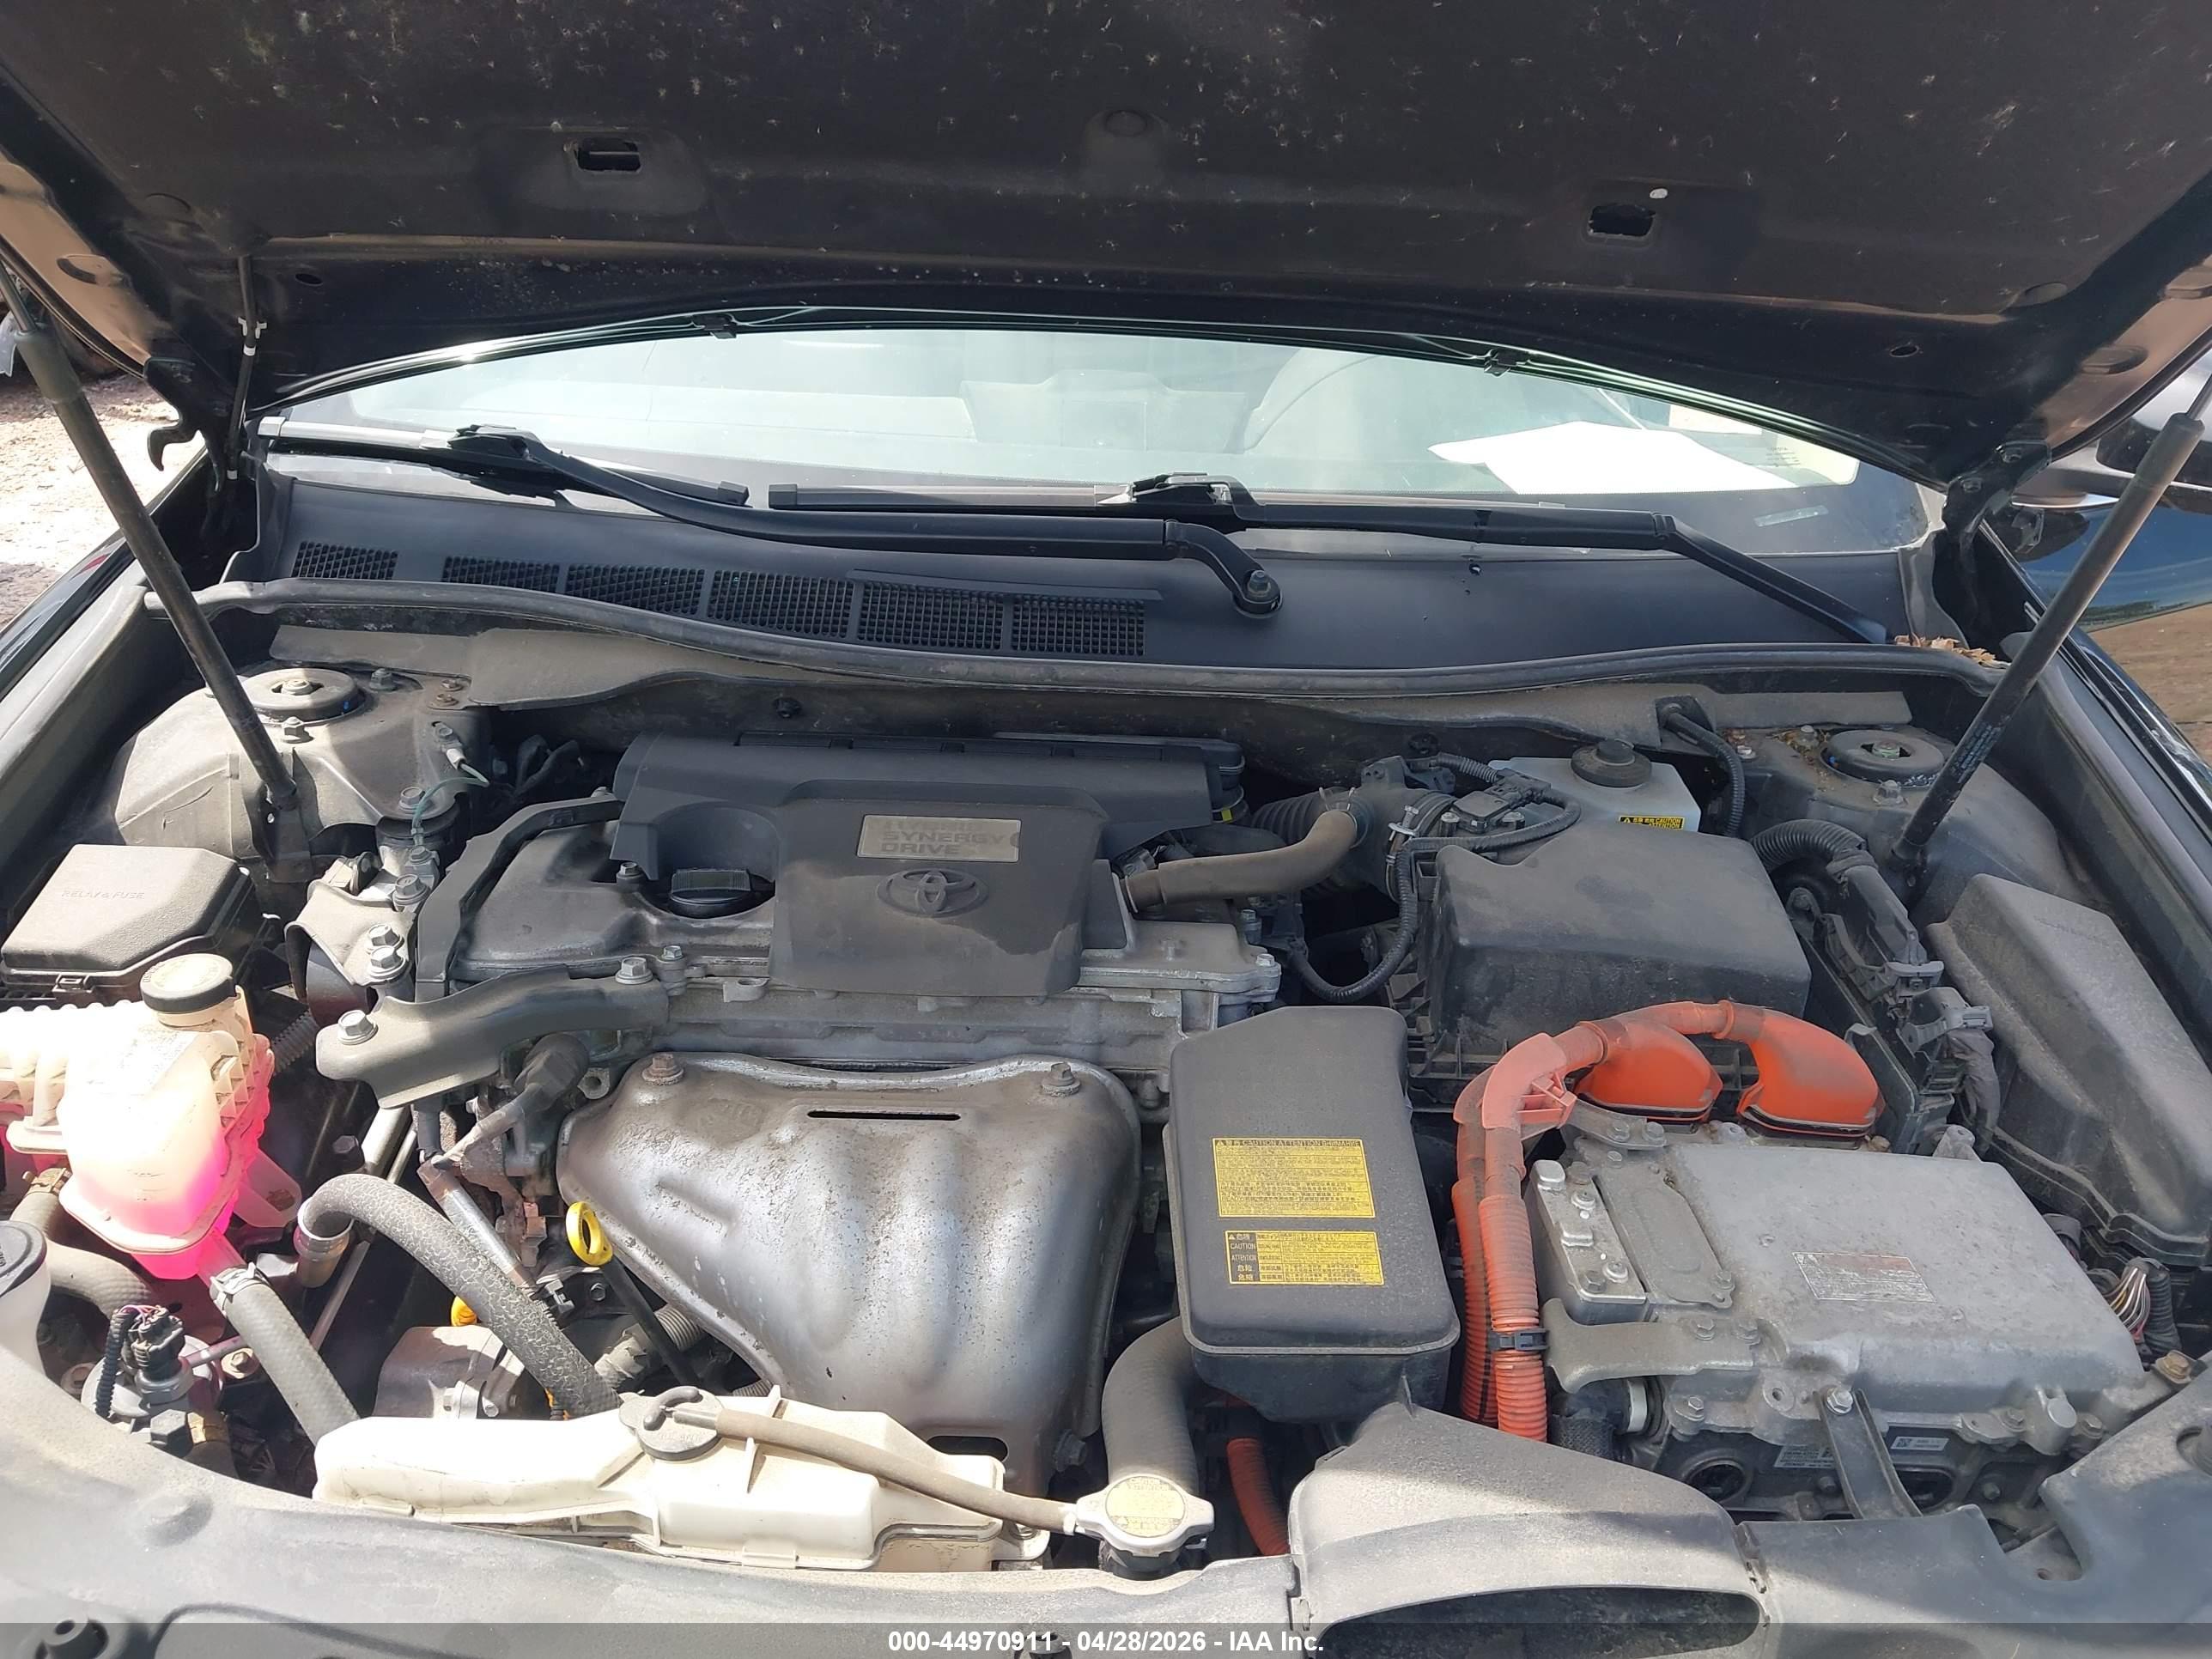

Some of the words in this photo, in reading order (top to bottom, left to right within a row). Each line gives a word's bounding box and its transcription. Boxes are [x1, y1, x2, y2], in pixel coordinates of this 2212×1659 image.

[884, 831, 1004, 844] SYNERGY
[881, 843, 962, 854] DRIVE
[112, 891, 145, 900] FUSE
